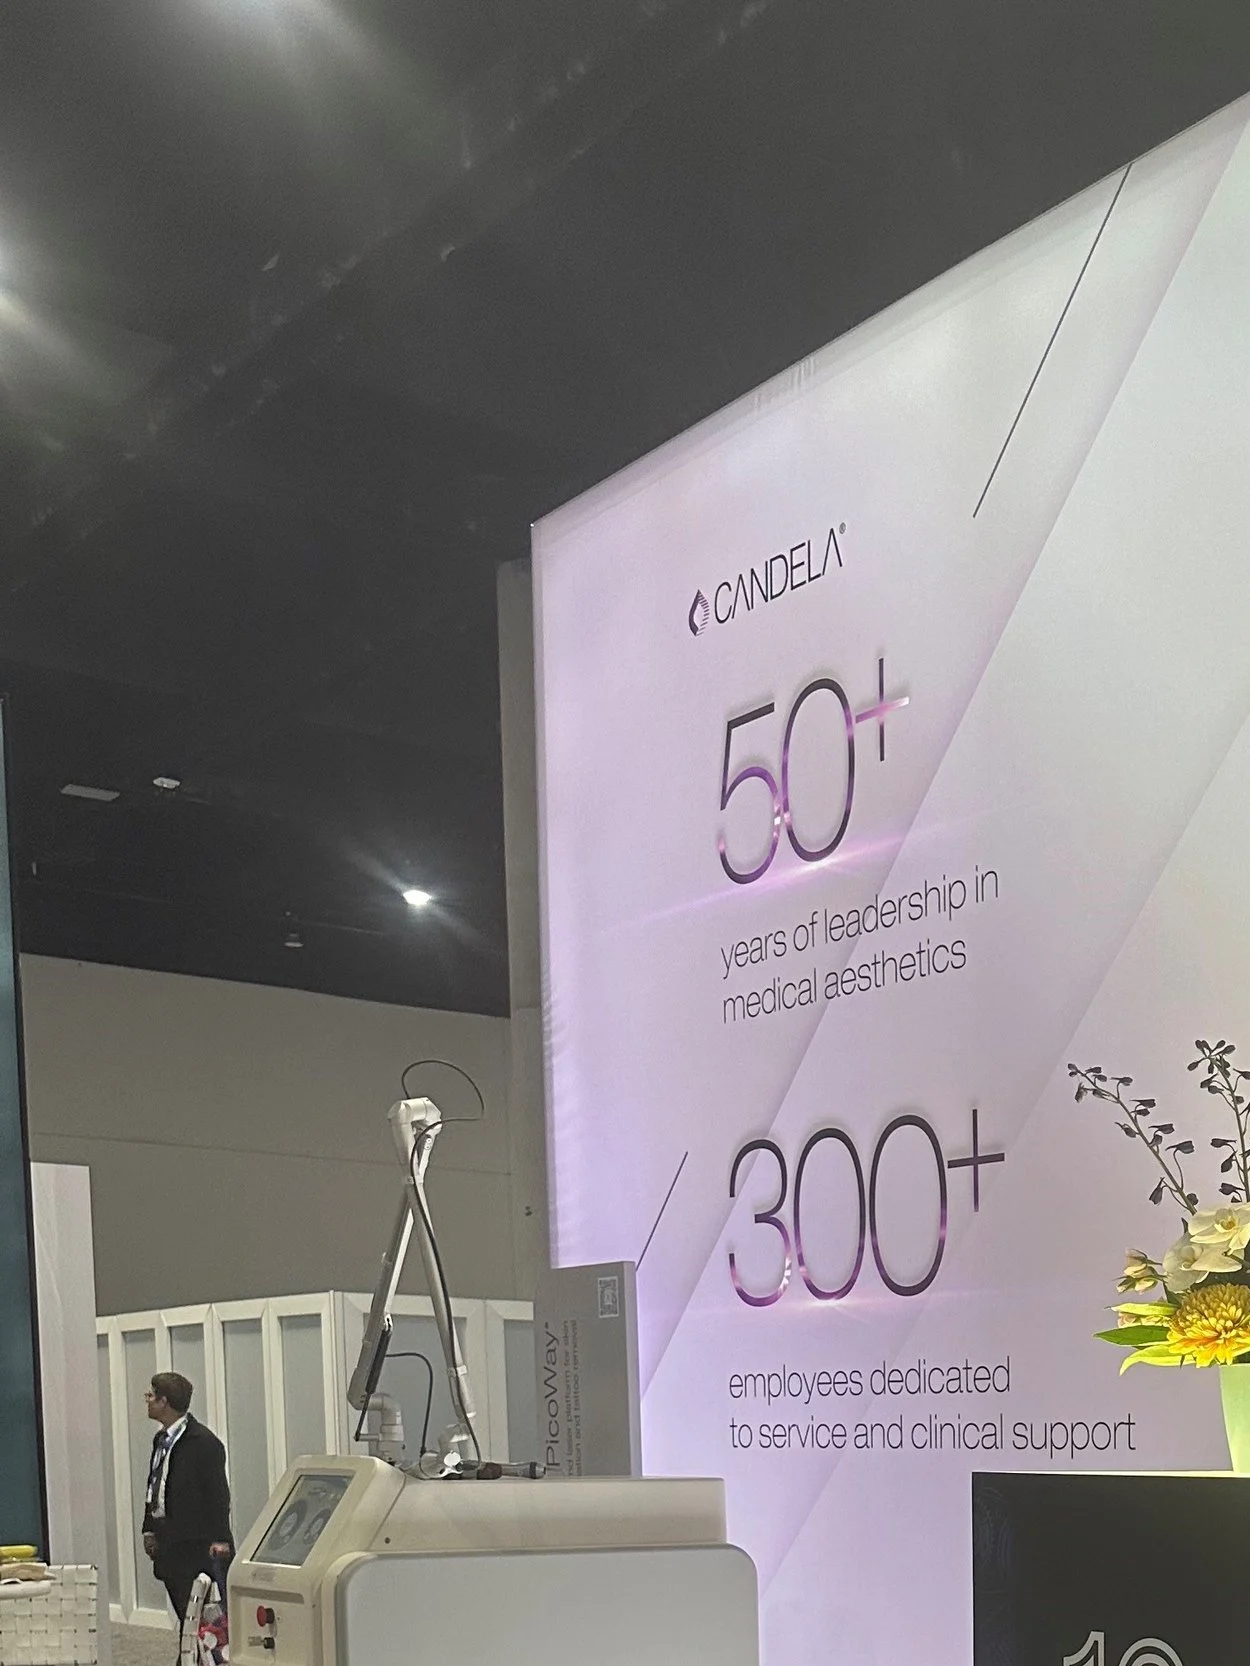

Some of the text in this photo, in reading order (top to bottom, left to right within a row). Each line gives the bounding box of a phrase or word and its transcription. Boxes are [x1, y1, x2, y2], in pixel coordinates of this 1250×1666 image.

[718, 657, 910, 885] 50+
[720, 864, 999, 980] years of leadership in
[723, 938, 967, 1025] medical aesthetics
[728, 1108, 1006, 1308] 300+
[729, 1355, 1010, 1406] employees dedicated
[729, 1413, 1137, 1460] to service and clinical support
